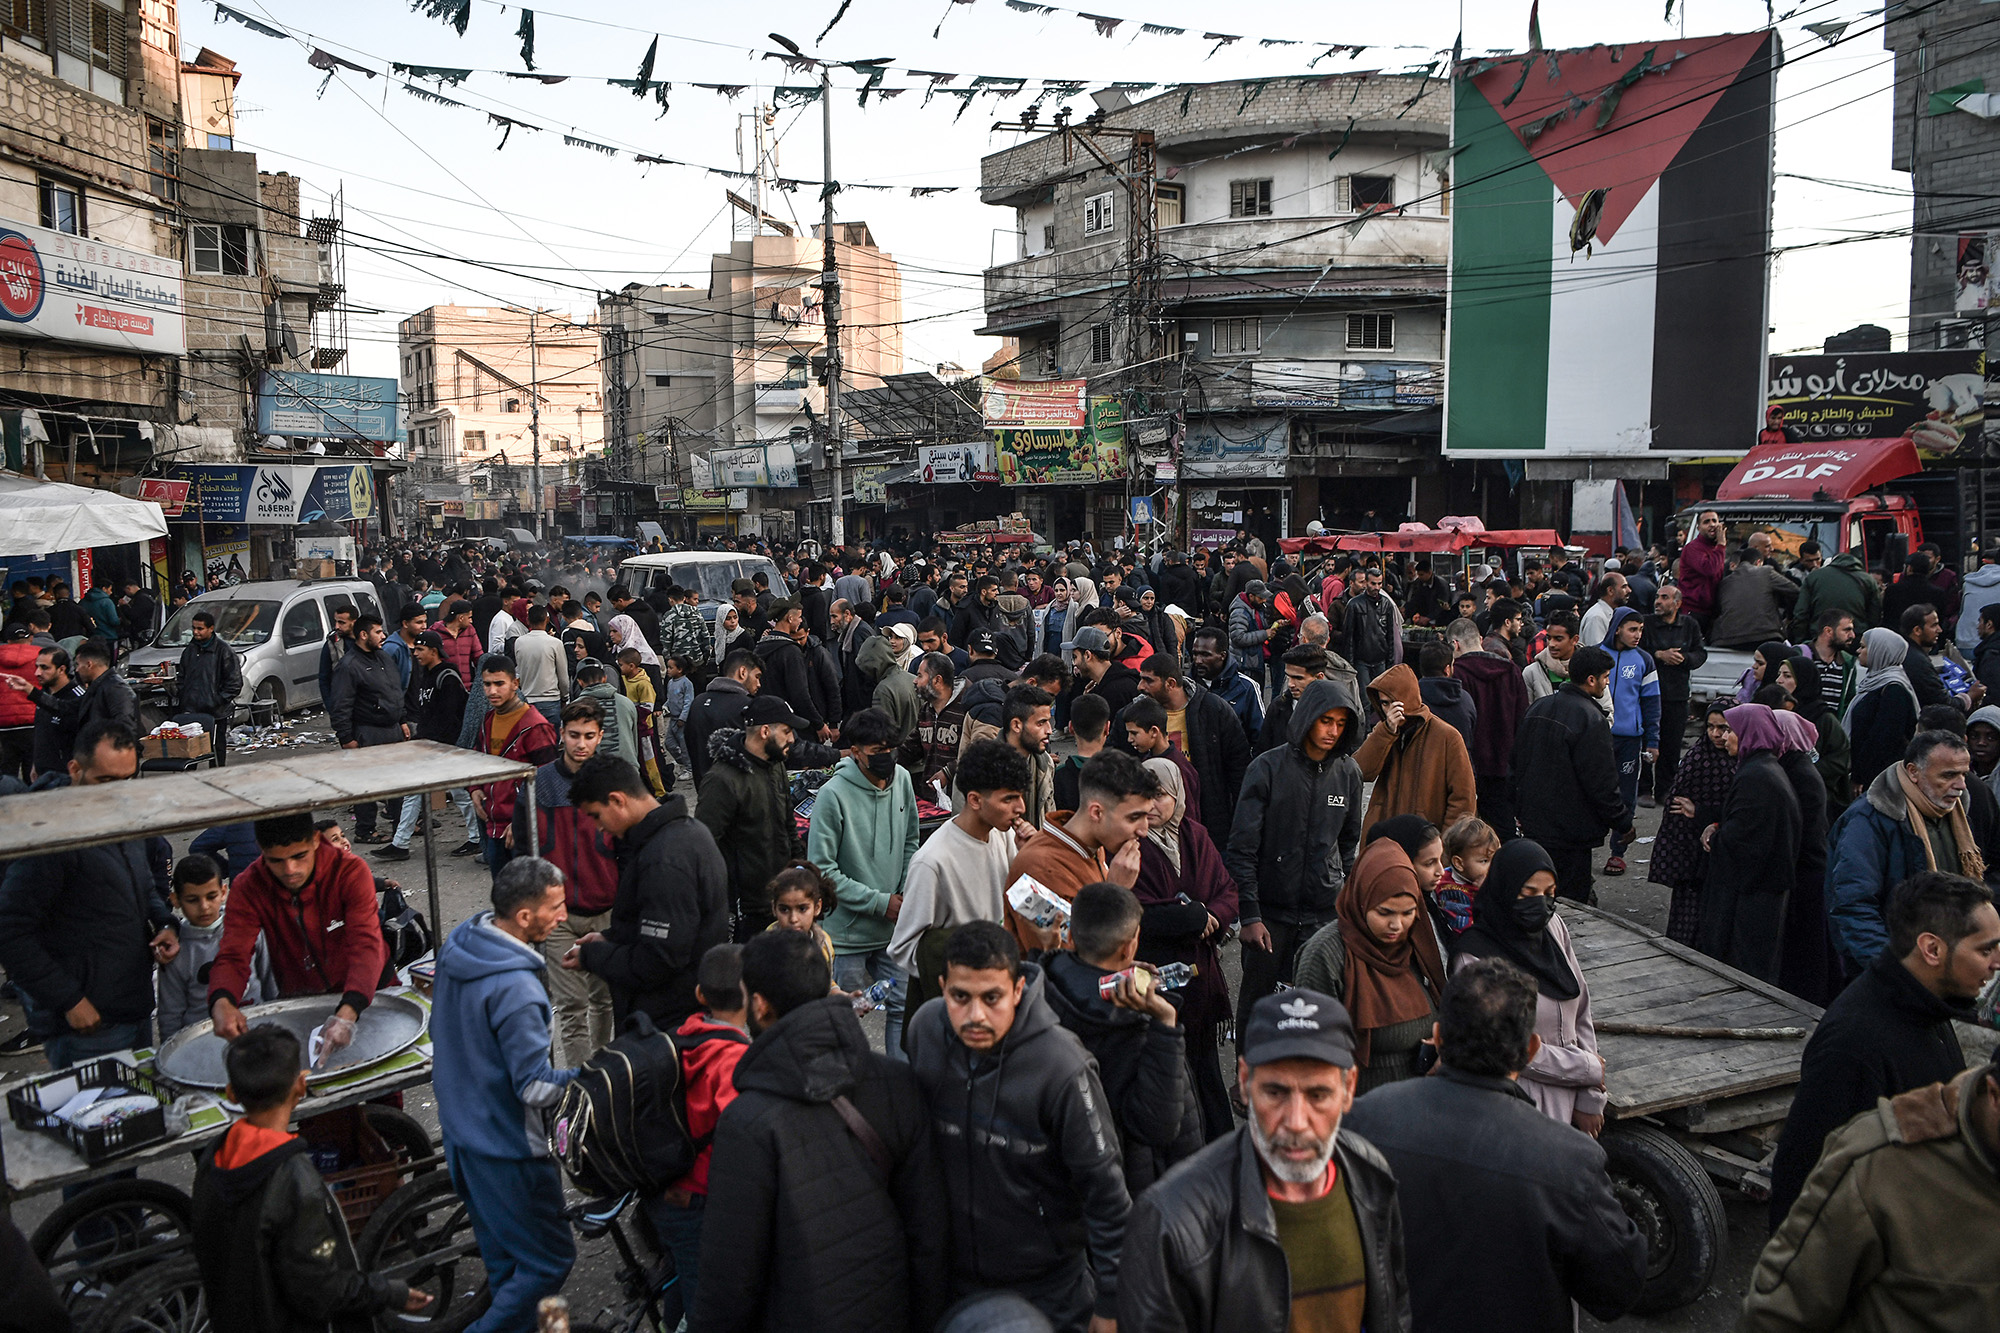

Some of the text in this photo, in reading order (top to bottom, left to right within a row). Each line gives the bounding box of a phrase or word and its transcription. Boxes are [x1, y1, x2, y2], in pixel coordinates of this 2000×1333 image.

[57, 264, 97, 291] الفنية
[136, 281, 177, 308] مطبعة
[118, 313, 129, 329] فن
[130, 317, 150, 331] لمسة
[1806, 357, 1846, 399] أبو
[1850, 368, 1925, 396] محلات
[1050, 381, 1076, 396] مخبز
[1045, 408, 1063, 421] الخبز
[1063, 408, 1079, 420] ربطة
[1098, 408, 1120, 420] عصائر
[1810, 407, 1854, 422] والطازج
[1857, 406, 1894, 420] للحبش
[1199, 434, 1266, 459] للصرافة
[929, 448, 960, 464] فون سيتي
[1753, 456, 1775, 467] العام
[199, 473, 238, 484] السراج
[1739, 462, 1842, 485] DAF
[200, 485, 220, 493] الطباع
[258, 504, 294, 513] ALSERAJ
[1217, 499, 1241, 509] العودة
[1204, 511, 1223, 522] صرافة
[1752, 513, 1785, 525] الحبيب
[1785, 513, 1804, 524] على
[1192, 533, 1218, 544] للصرافة
[227, 542, 248, 552] هدايا
[1327, 795, 1345, 804] EA7
[1277, 1017, 1320, 1031] adidas
